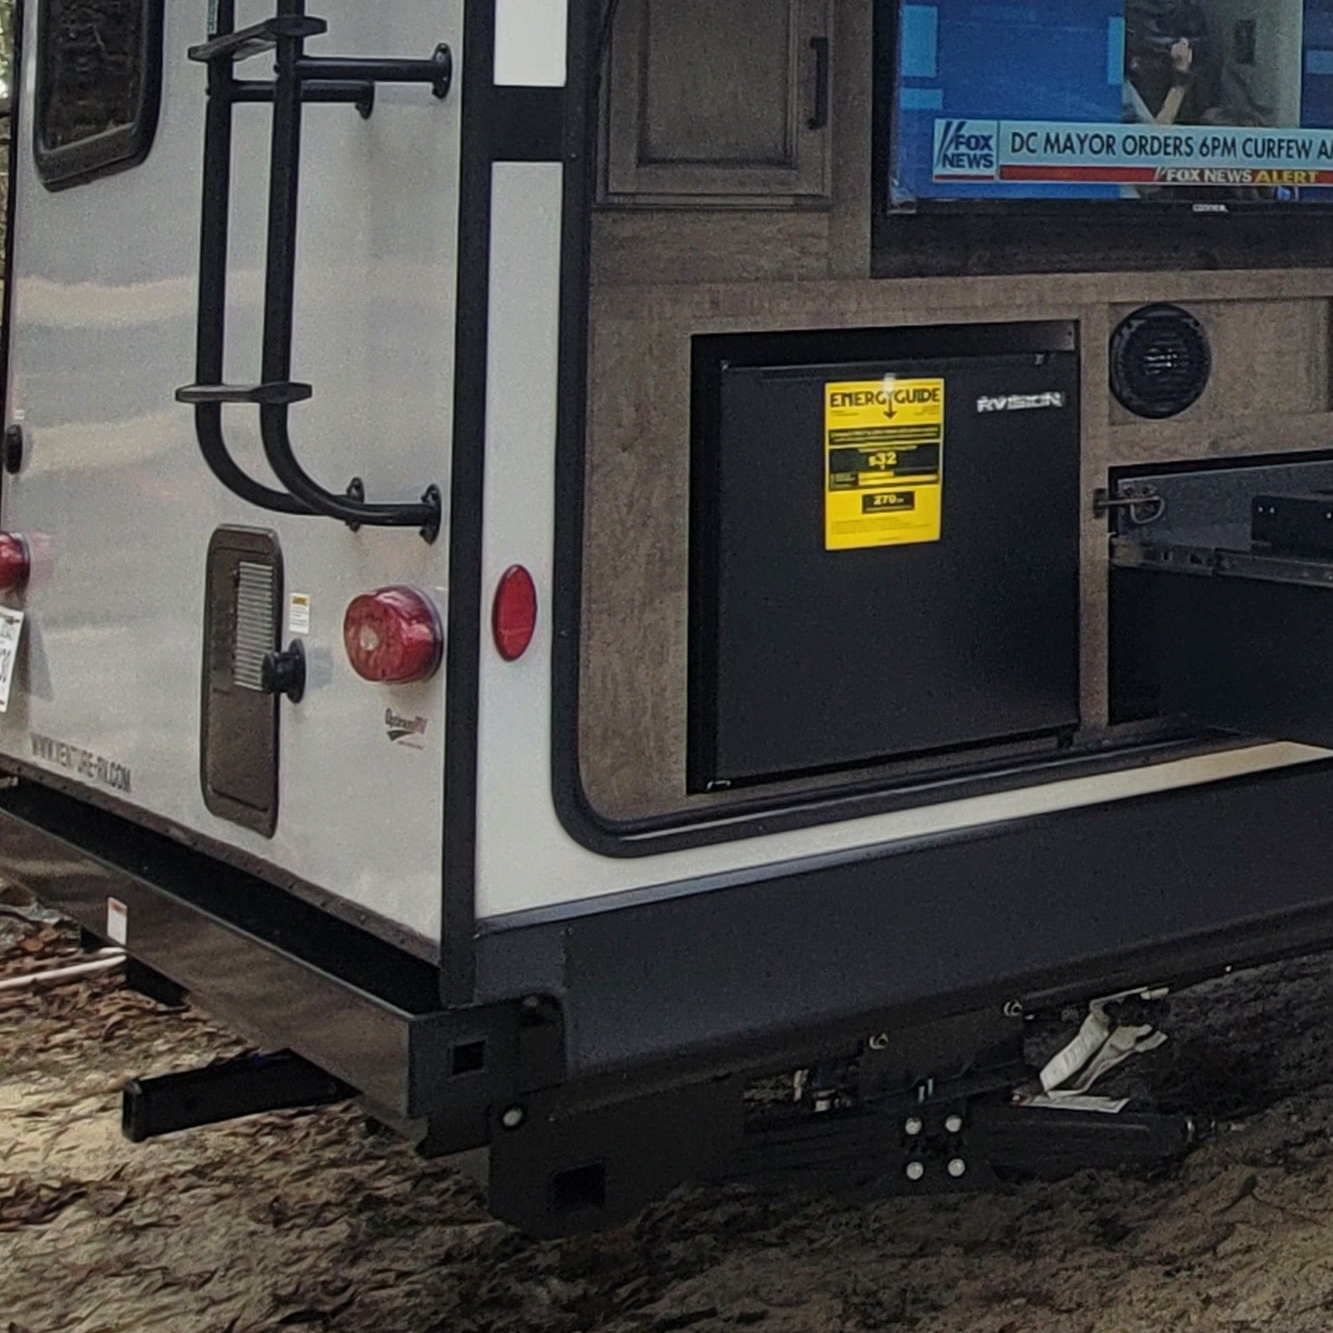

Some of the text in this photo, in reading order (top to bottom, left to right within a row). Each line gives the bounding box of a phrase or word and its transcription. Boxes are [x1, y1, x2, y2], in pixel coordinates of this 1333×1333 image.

[953, 134, 994, 152] FOX
[1011, 132, 1038, 154] DC
[1043, 132, 1116, 156] MAYOR
[1122, 135, 1195, 157] ORDERS
[1200, 136, 1237, 158] 6PM
[1241, 137, 1313, 160] CURFEW
[942, 153, 994, 169] NEWS
[1166, 168, 1319, 183] FOX NEWS ALERT
